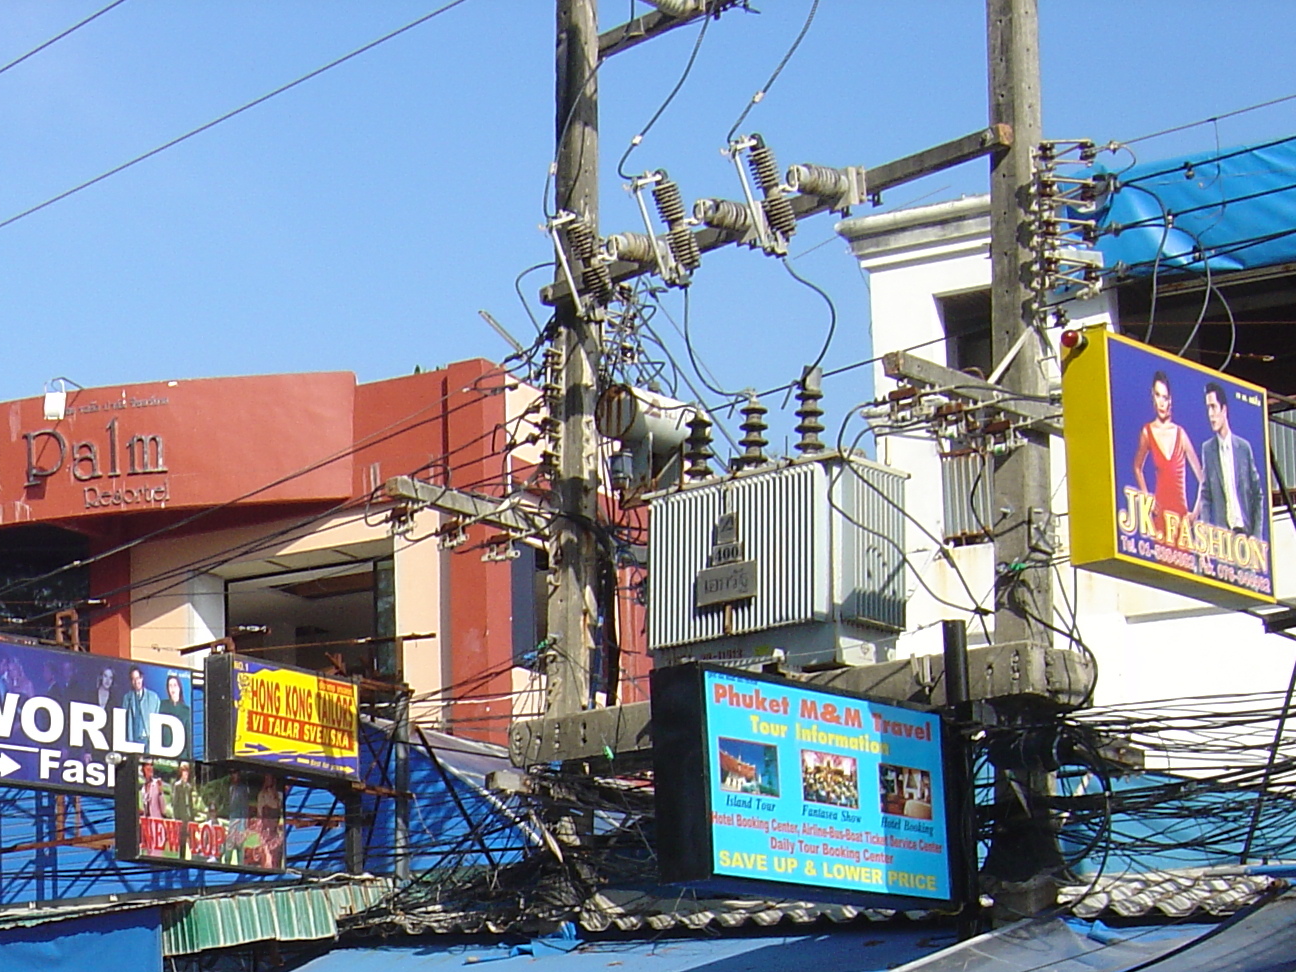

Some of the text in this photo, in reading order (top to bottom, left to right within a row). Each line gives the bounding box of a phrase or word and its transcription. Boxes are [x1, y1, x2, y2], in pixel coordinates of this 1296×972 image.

[23, 416, 168, 488] Palm
[251, 678, 281, 715] HONG
[285, 685, 312, 722] KONG
[316, 692, 353, 729] TAILORS
[713, 683, 932, 743] Phuket M&M Travel
[252, 713, 349, 749] VI TALAR SVENSKA
[750, 715, 890, 756] Tour Information
[726, 794, 775, 813] Island Tour
[841, 810, 862, 824] Show
[140, 816, 182, 852] NEW
[188, 821, 225, 857] TOP
[711, 811, 735, 826] Hotel
[736, 814, 769, 833] Booking
[771, 819, 800, 836] Center,
[890, 836, 921, 851] Service
[918, 840, 942, 854] Center
[882, 816, 934, 837] Hotel Booking
[719, 850, 938, 890] SAVE UP & LOWER PRICE
[770, 837, 894, 864] Daily Tour Booking Center
